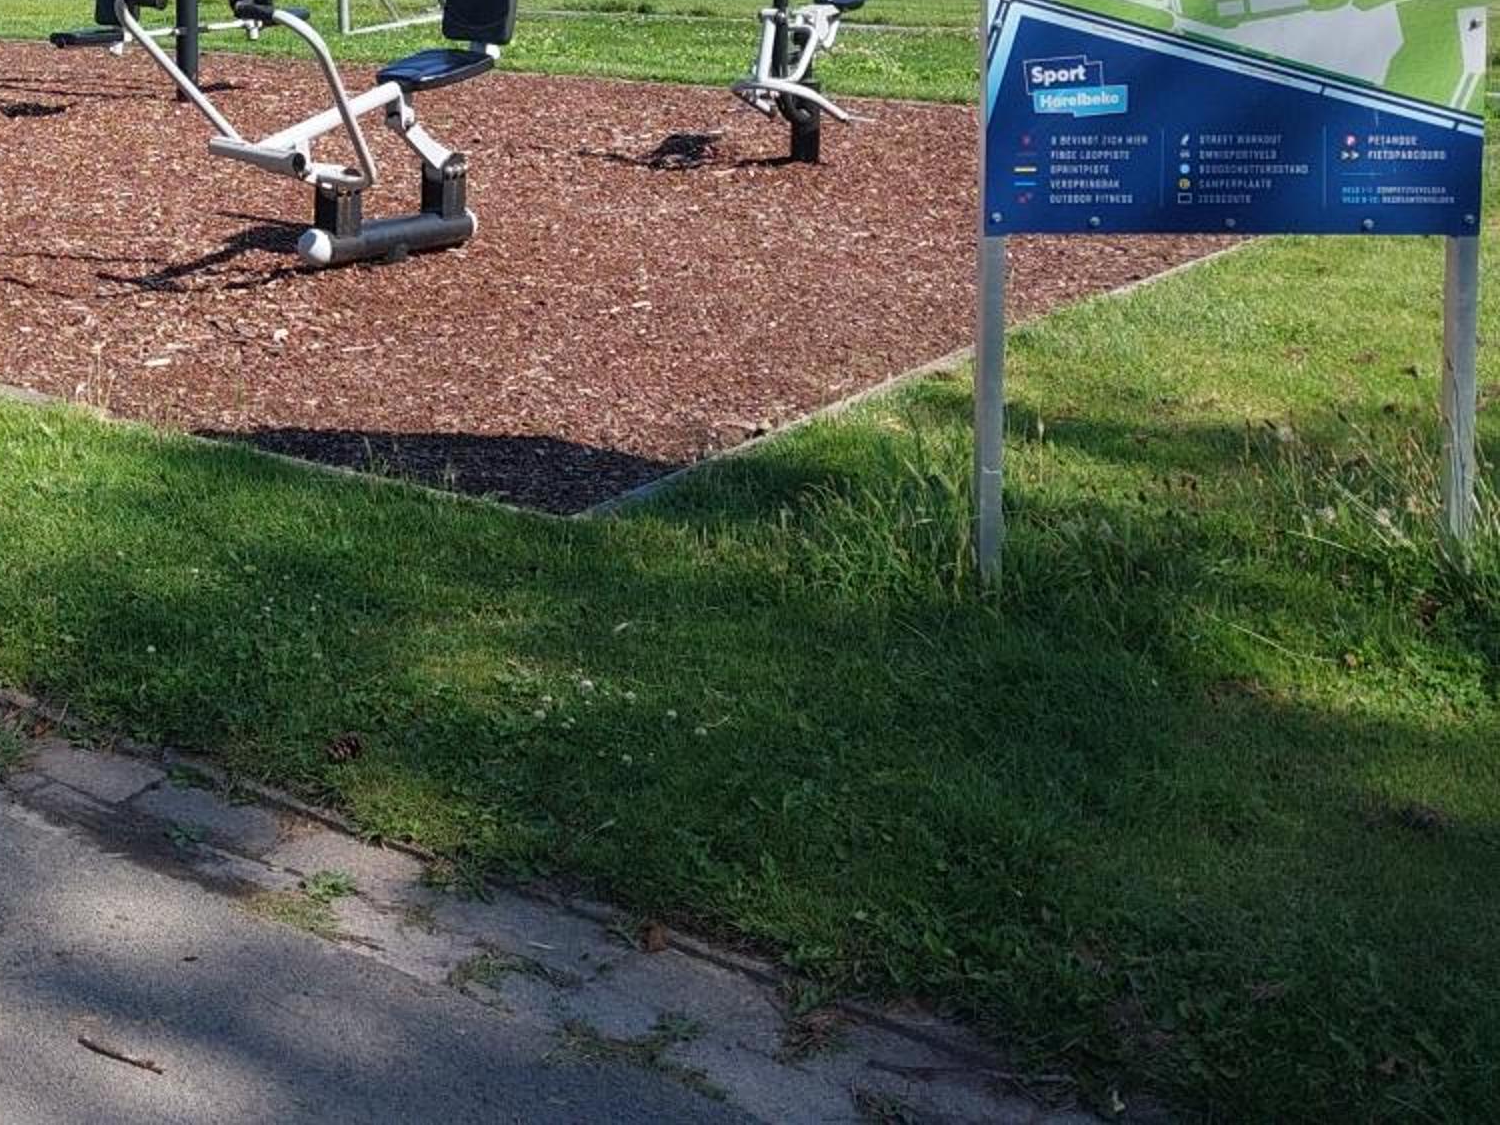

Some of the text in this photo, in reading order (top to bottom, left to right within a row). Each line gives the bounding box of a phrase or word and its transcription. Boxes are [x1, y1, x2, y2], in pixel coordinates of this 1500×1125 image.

[1031, 64, 1087, 86] Sport
[1040, 91, 1119, 108] Harelbeke
[1050, 194, 1133, 204] OUTDOOR FITNESS
